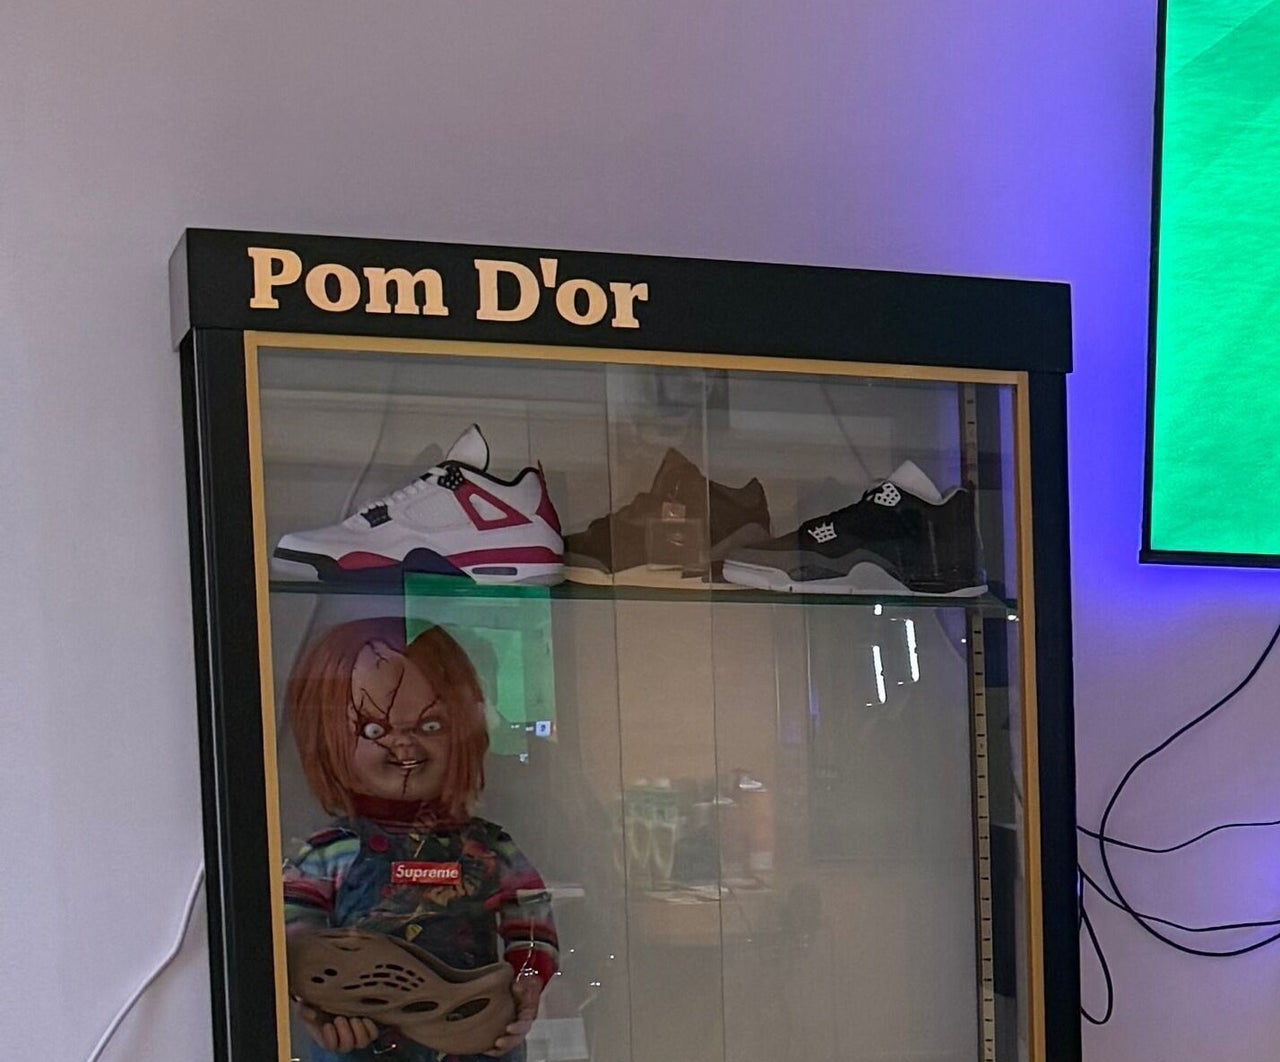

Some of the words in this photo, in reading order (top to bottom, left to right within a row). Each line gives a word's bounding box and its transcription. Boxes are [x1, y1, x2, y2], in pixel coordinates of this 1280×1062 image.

[247, 246, 450, 317] Pom
[473, 257, 649, 329] D'or
[395, 864, 460, 882] Supreme
